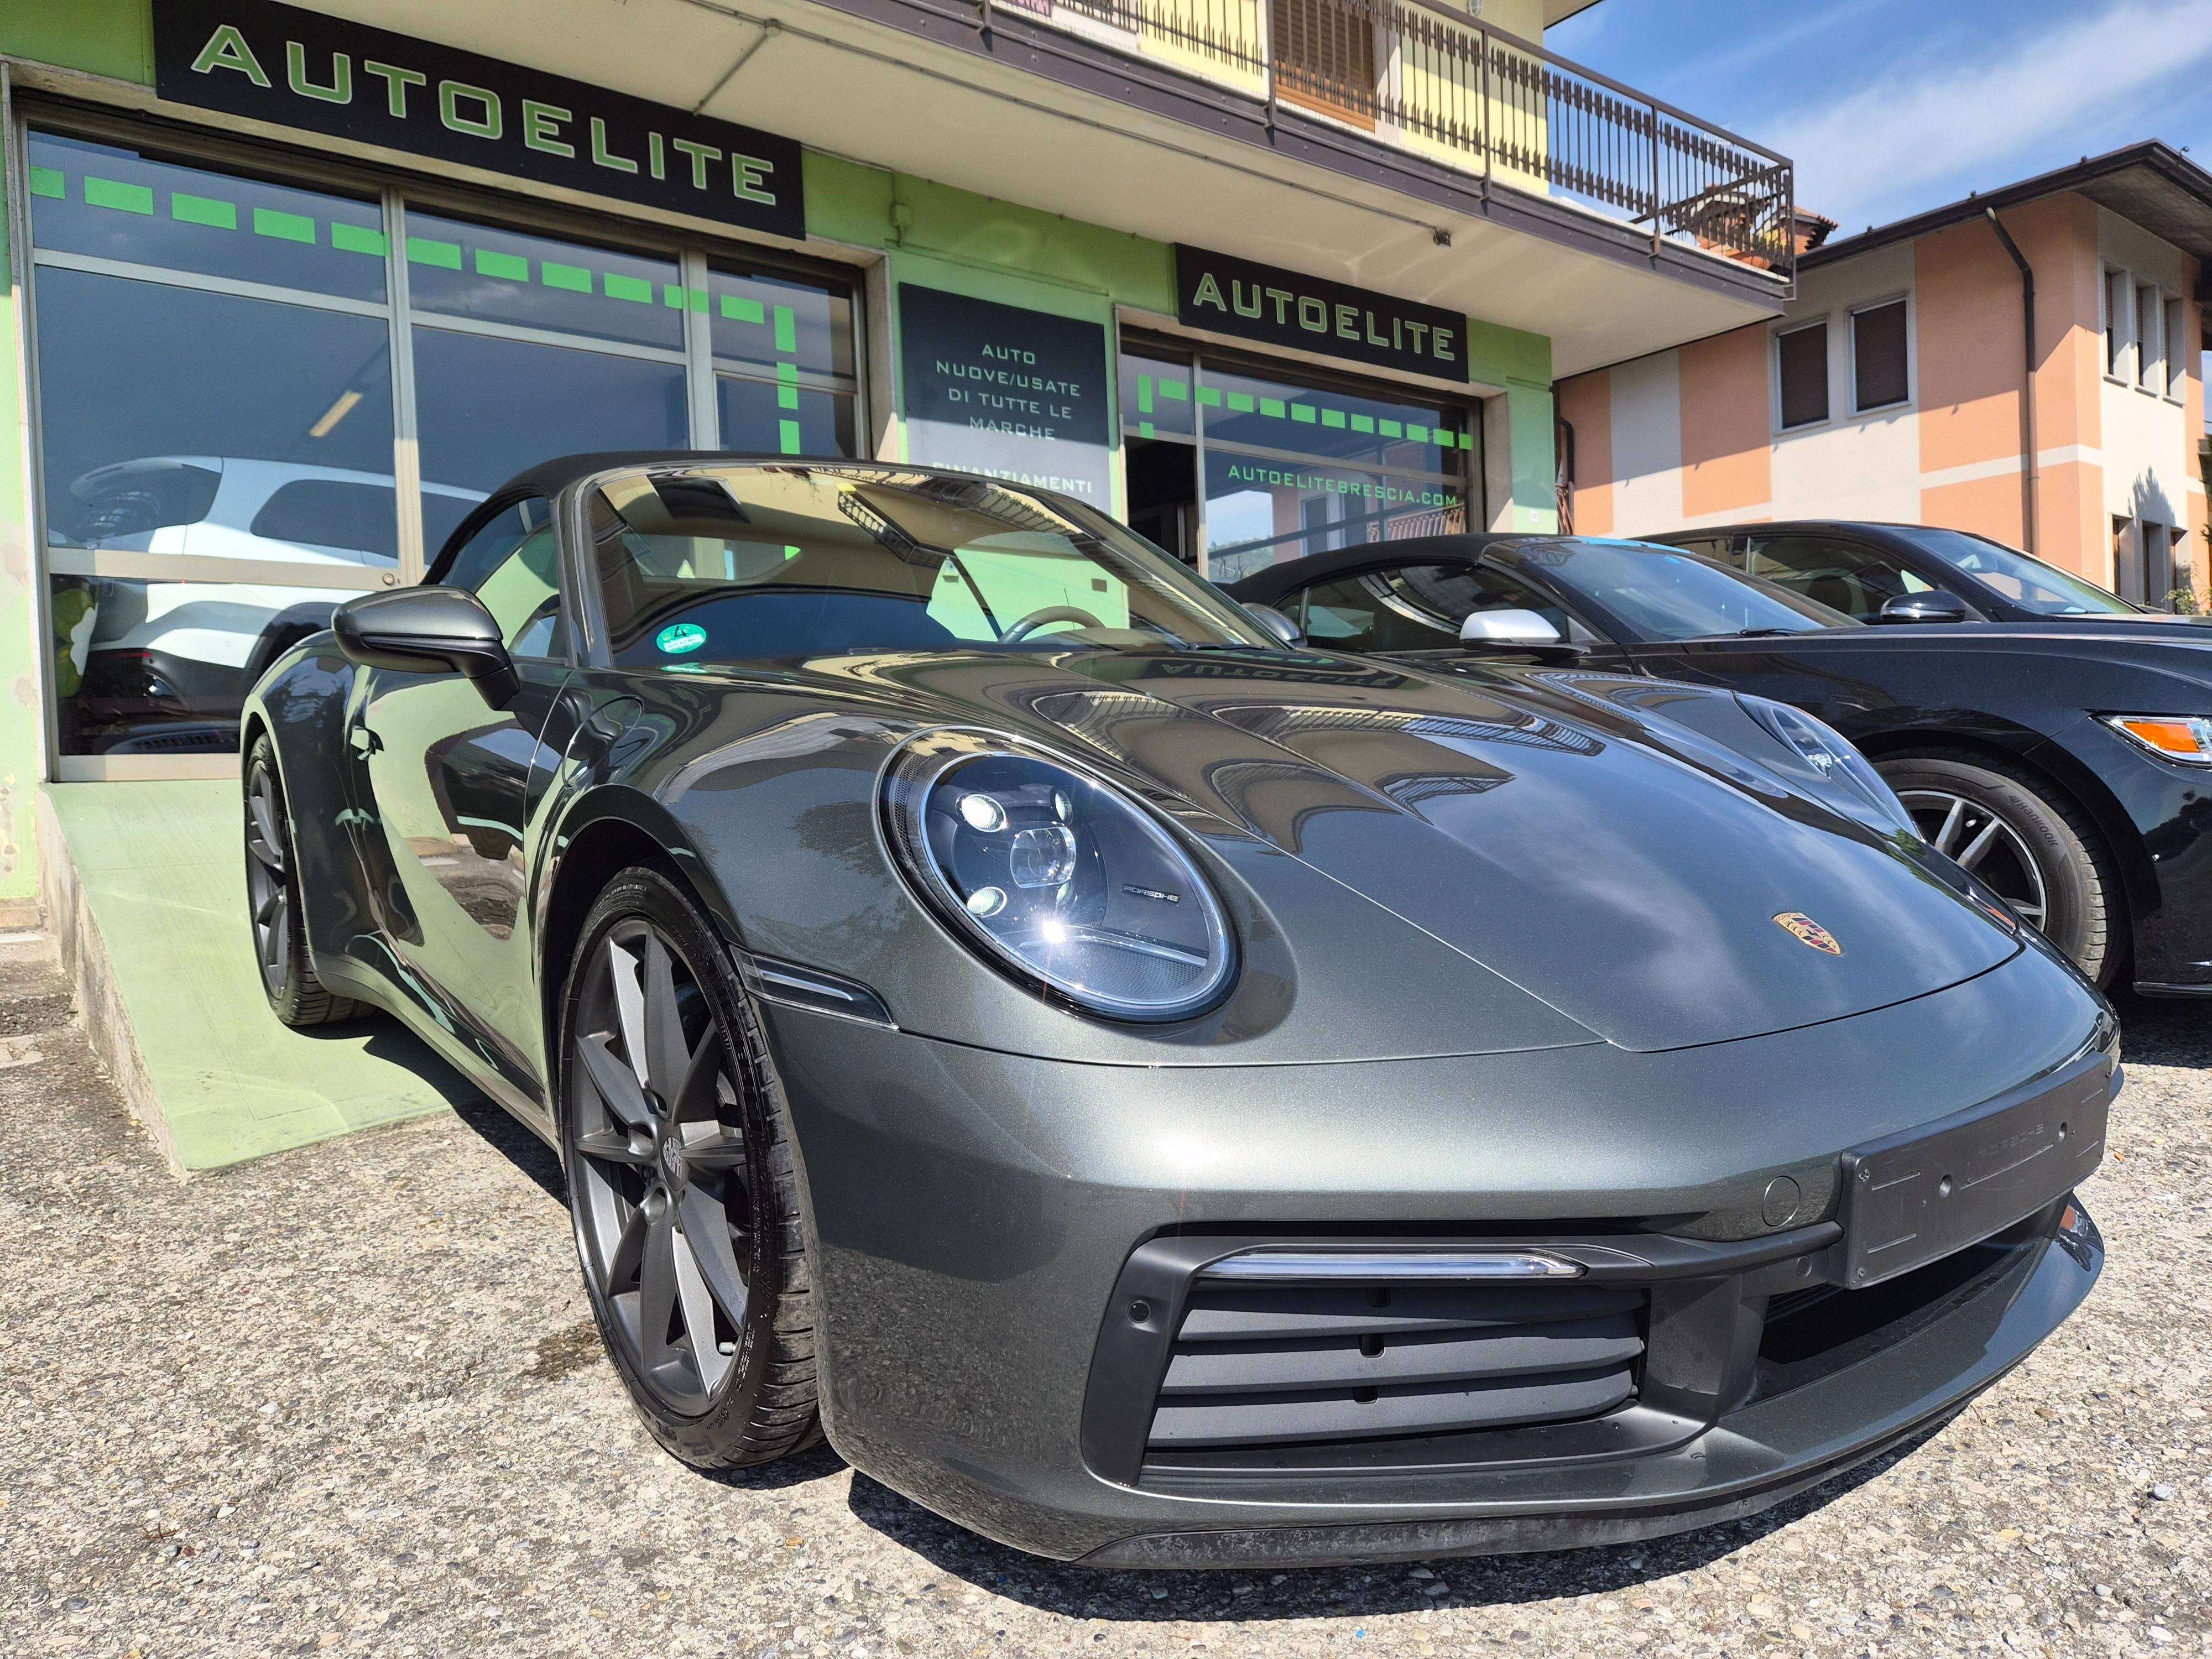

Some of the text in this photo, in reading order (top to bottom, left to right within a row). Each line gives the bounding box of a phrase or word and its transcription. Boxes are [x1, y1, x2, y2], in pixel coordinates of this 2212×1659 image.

[190, 24, 775, 206] AUTOELITE
[1193, 273, 1454, 361] AUTOELITE
[982, 343, 1036, 365] AUTO
[936, 360, 1081, 397] NUOVE/USATE
[948, 388, 1072, 420] DI TUTTE LE
[969, 416, 1055, 441] MARCHE
[1228, 465, 1457, 507] AUTOELITEBRESCIA.COM
[1123, 885, 1179, 902] PORSCHE
